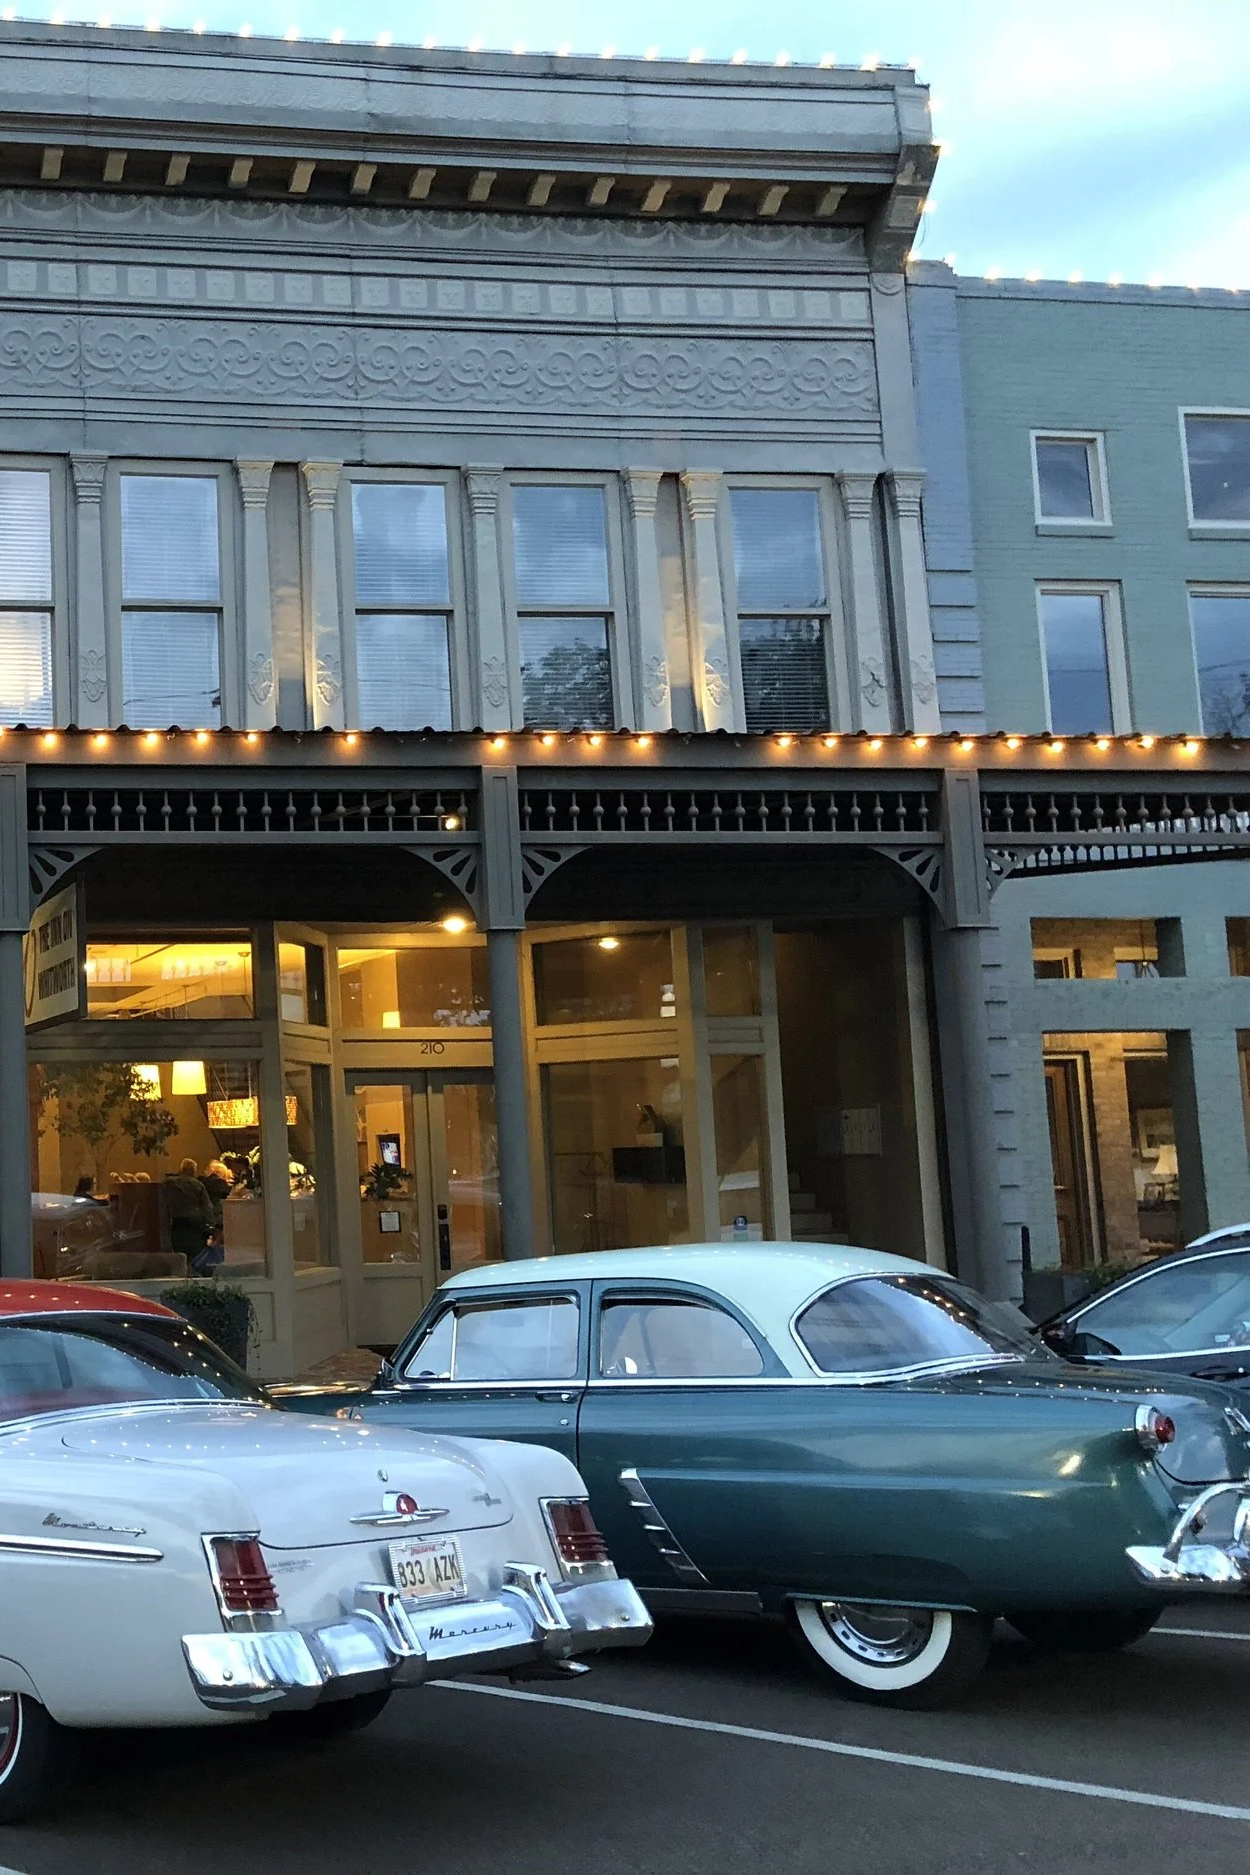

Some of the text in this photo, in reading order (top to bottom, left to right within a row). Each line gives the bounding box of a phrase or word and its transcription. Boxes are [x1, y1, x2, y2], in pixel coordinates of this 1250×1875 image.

[420, 1042, 445, 1055] 210
[434, 1554, 460, 1583] AZK
[429, 1622, 517, 1641] Mercury
